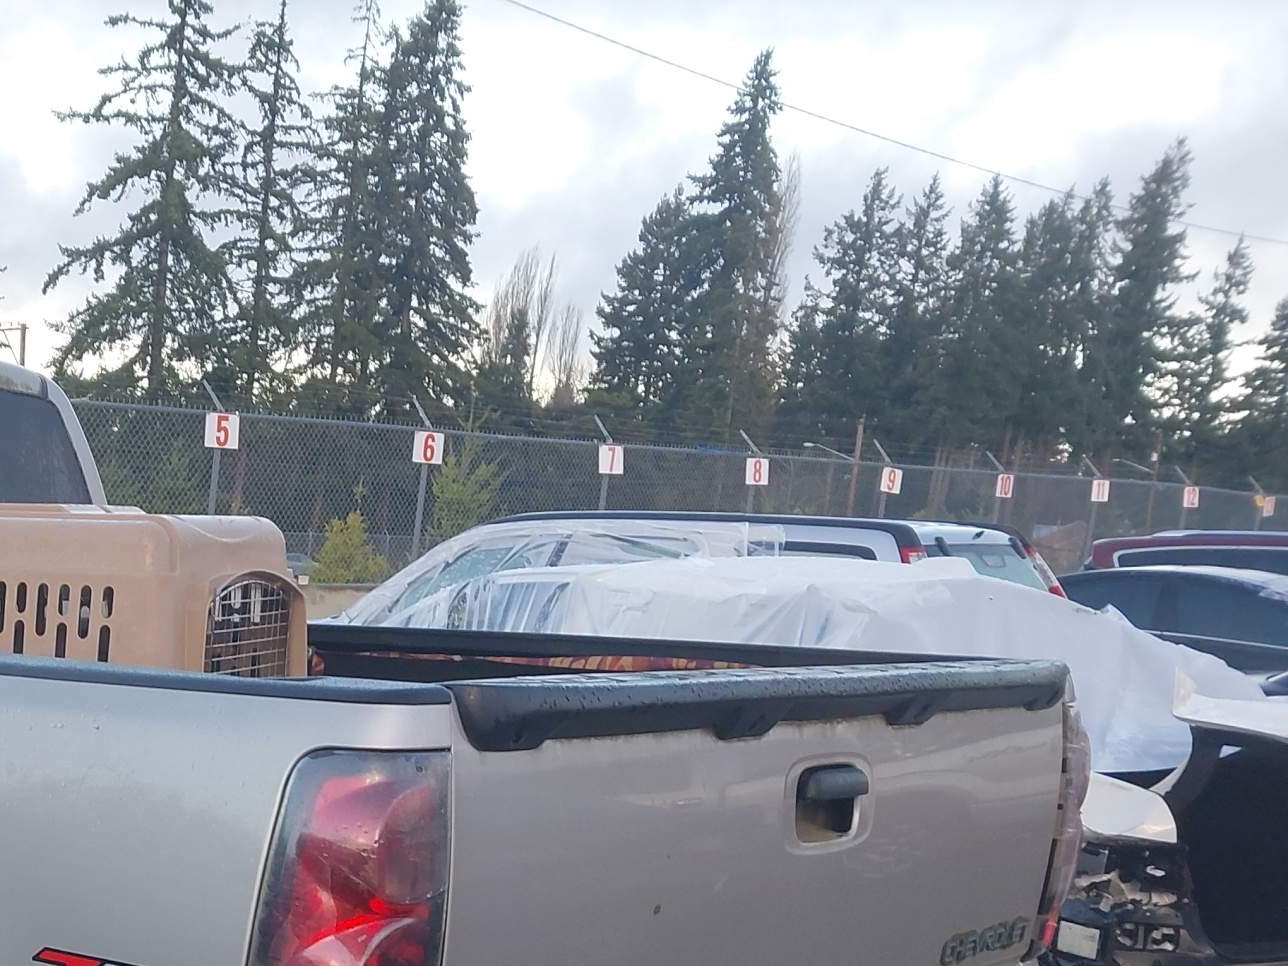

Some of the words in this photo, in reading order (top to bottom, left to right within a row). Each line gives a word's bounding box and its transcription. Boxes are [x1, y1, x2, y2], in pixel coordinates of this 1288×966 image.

[215, 415, 230, 448] 5
[423, 433, 435, 462] 6
[607, 446, 617, 473] 7
[752, 459, 762, 483] 8
[887, 470, 896, 491] 9
[999, 475, 1011, 496] 10
[1097, 481, 1106, 500] 11
[1186, 488, 1196, 506] 12
